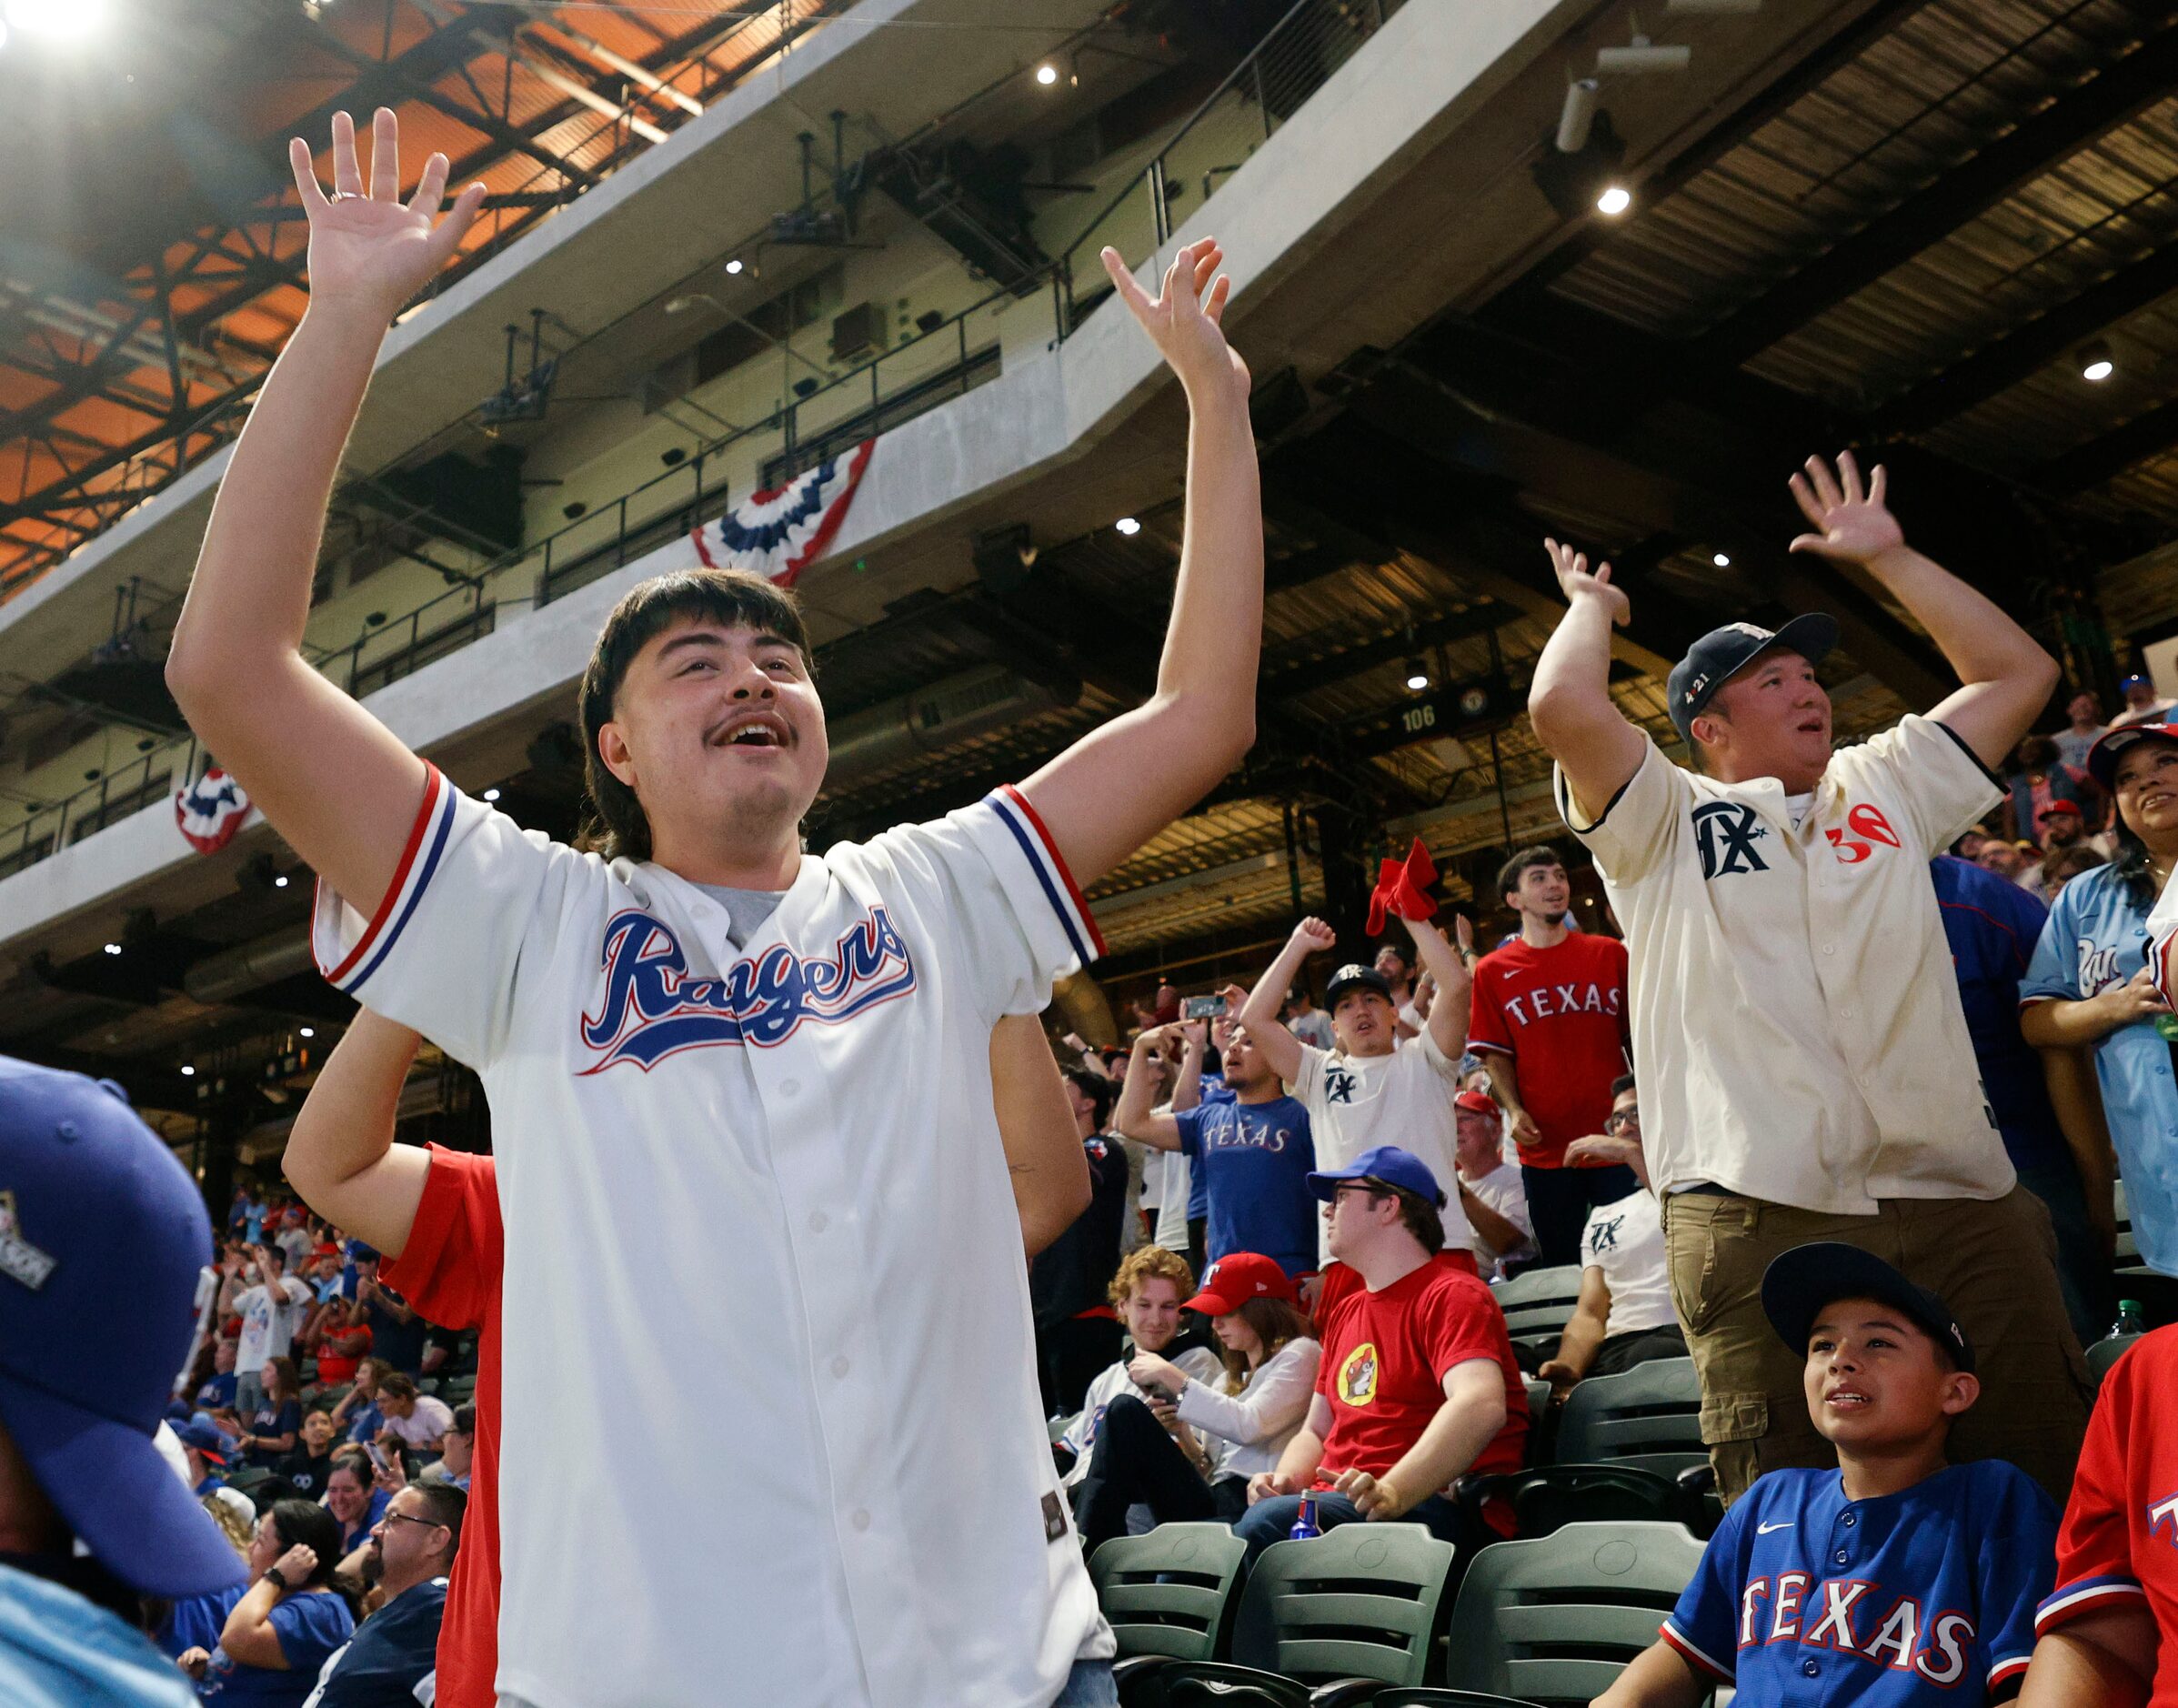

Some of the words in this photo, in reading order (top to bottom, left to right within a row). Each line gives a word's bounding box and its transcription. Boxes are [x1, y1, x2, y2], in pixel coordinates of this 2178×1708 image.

[1402, 705, 1435, 731] 106
[577, 907, 918, 1074] Rangers
[1504, 982, 1621, 1026] TEXAS
[1204, 1124, 1291, 1152] TEXAS
[1737, 1571, 1976, 1689] TEXAS
